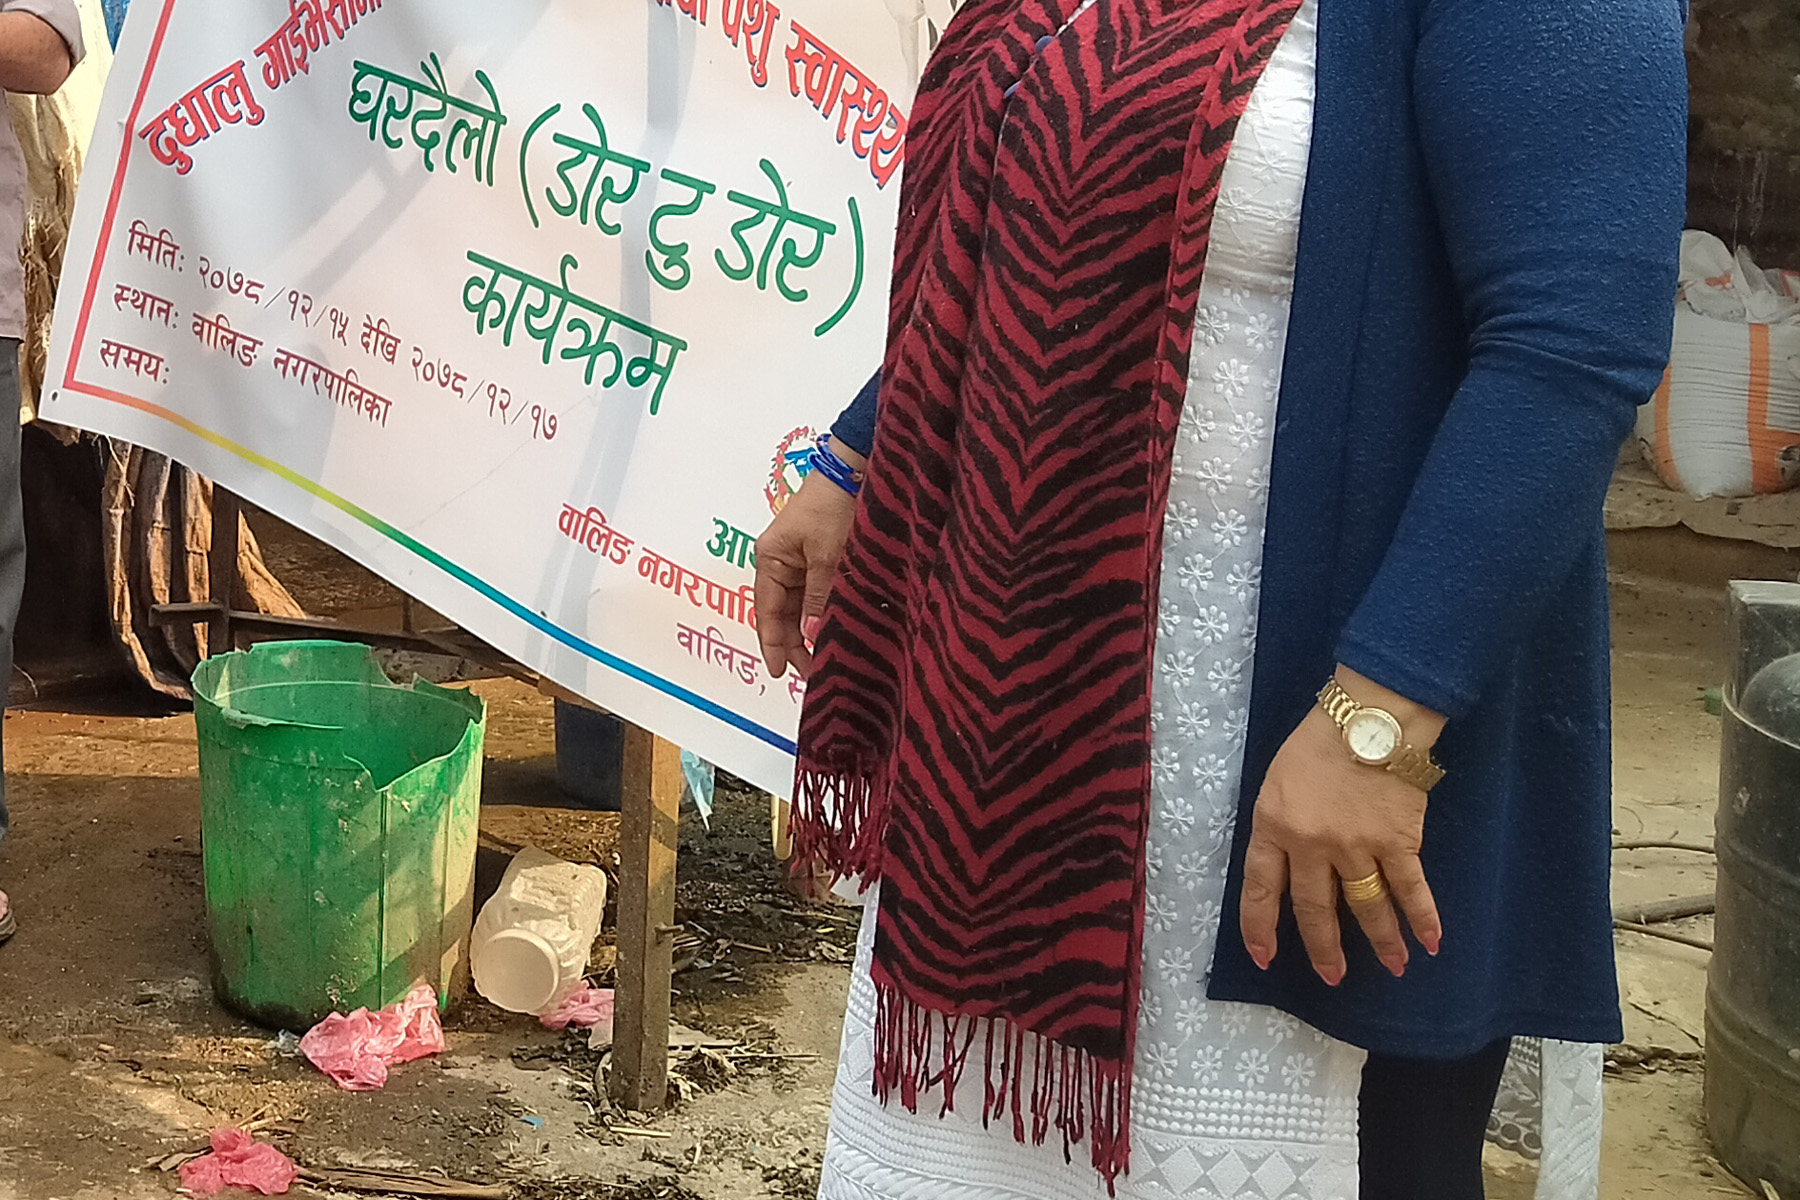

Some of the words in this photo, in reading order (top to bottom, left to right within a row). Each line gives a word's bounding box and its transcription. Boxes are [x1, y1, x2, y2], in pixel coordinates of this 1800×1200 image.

[138, 59, 265, 175] दुधालु
[349, 52, 507, 187] घरदैलो
[646, 168, 716, 290] टु
[273, 348, 392, 428] नगरपालिका
[361, 314, 401, 365] देखि
[461, 250, 687, 415] कार्यक्रम
